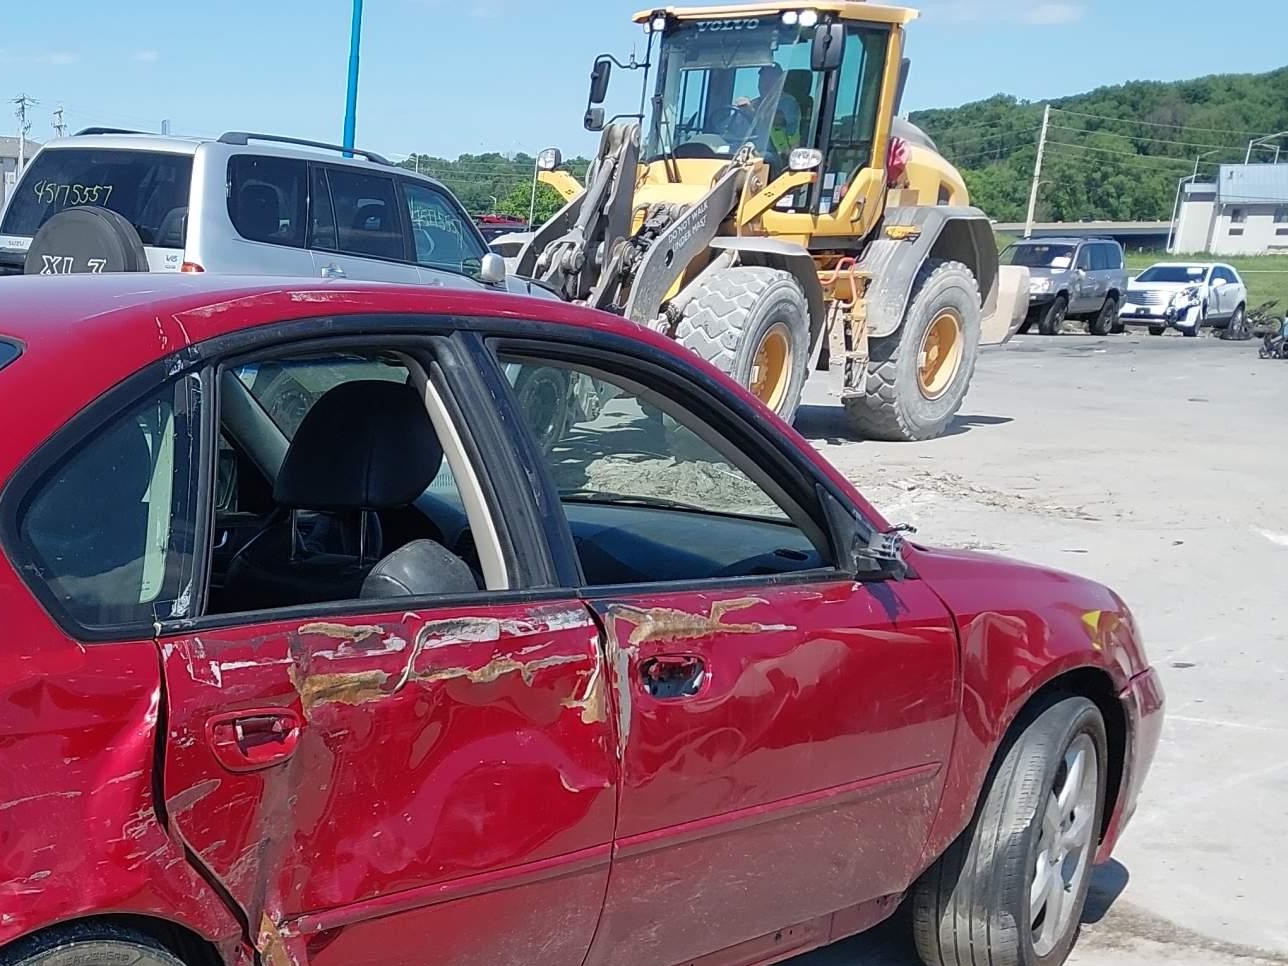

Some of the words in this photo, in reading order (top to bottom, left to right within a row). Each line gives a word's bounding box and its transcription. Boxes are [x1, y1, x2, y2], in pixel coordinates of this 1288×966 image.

[696, 18, 760, 32] VOLVO
[34, 180, 113, 206] 45175557
[668, 229, 678, 243] DO
[677, 215, 691, 236] NOT
[692, 200, 708, 221] WALK
[672, 230, 692, 252] UNDER
[692, 215, 707, 234] MAST
